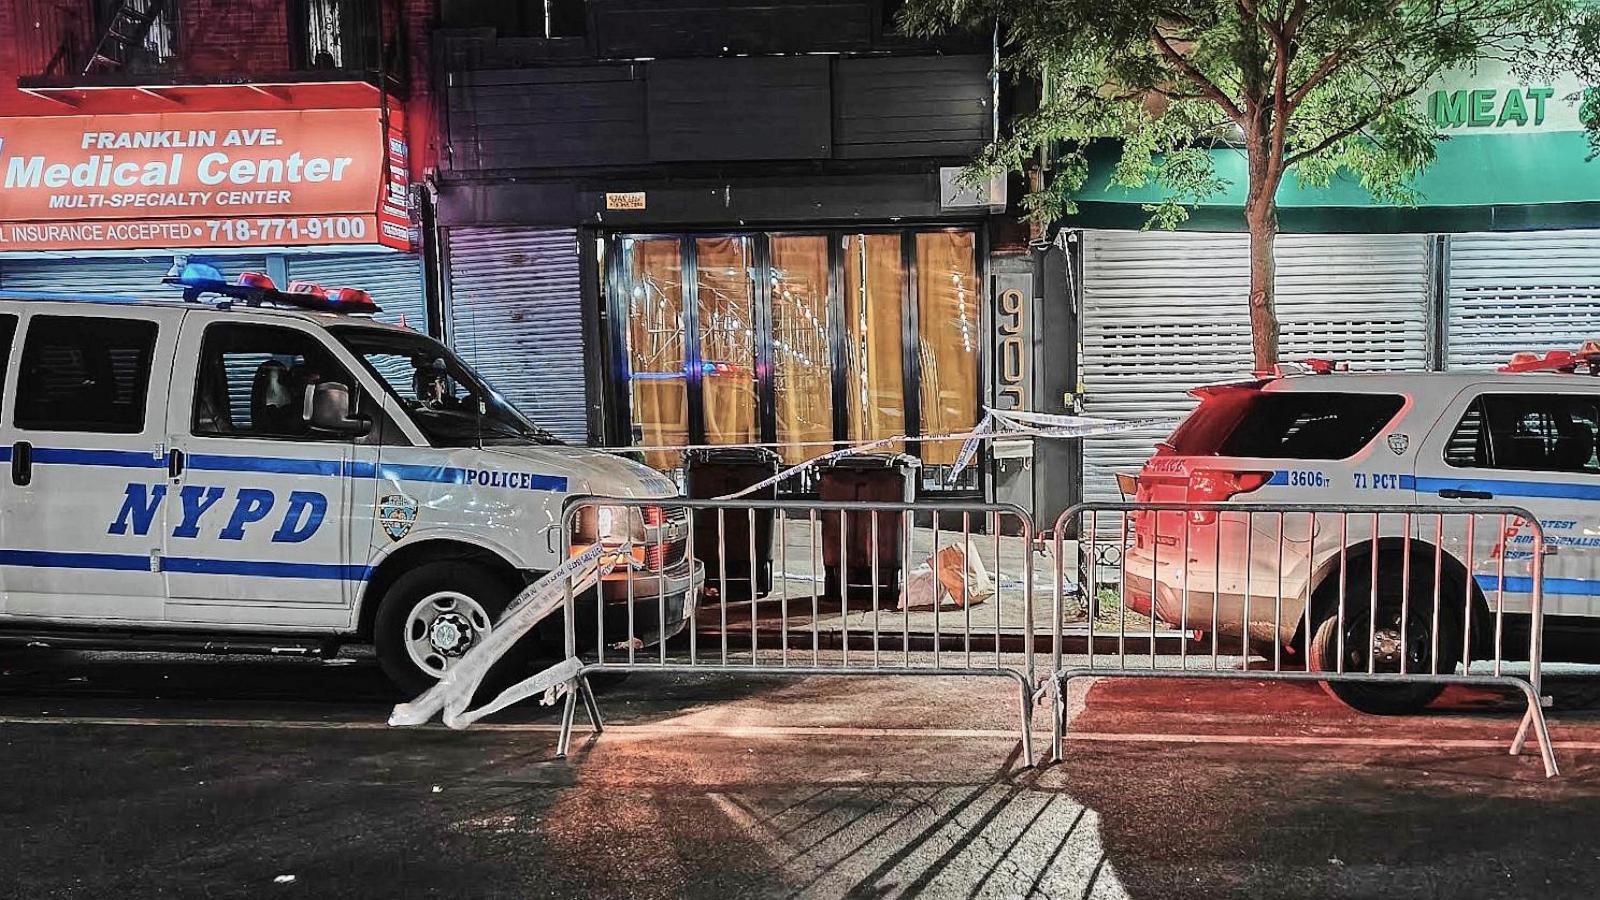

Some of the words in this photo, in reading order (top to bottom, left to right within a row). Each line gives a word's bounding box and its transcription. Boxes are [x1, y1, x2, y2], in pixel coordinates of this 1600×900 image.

[1428, 87, 1554, 128] MEAT
[81, 130, 216, 149] FRANKLIN
[223, 128, 284, 147] AVE.
[4, 153, 183, 188] Medical
[197, 151, 352, 185] Center
[49, 192, 212, 208] MULTI-SPECIALTY
[215, 190, 292, 205] CENTER
[12, 225, 103, 242] INSURANCE
[106, 223, 191, 241] ACCEPTED
[206, 217, 365, 241] 718-771-9100
[465, 469, 531, 489] POLICE
[1291, 471, 1323, 486] 3606
[1353, 473, 1367, 488] 71
[1372, 473, 1397, 489] PCT
[107, 482, 328, 543] NYPD
